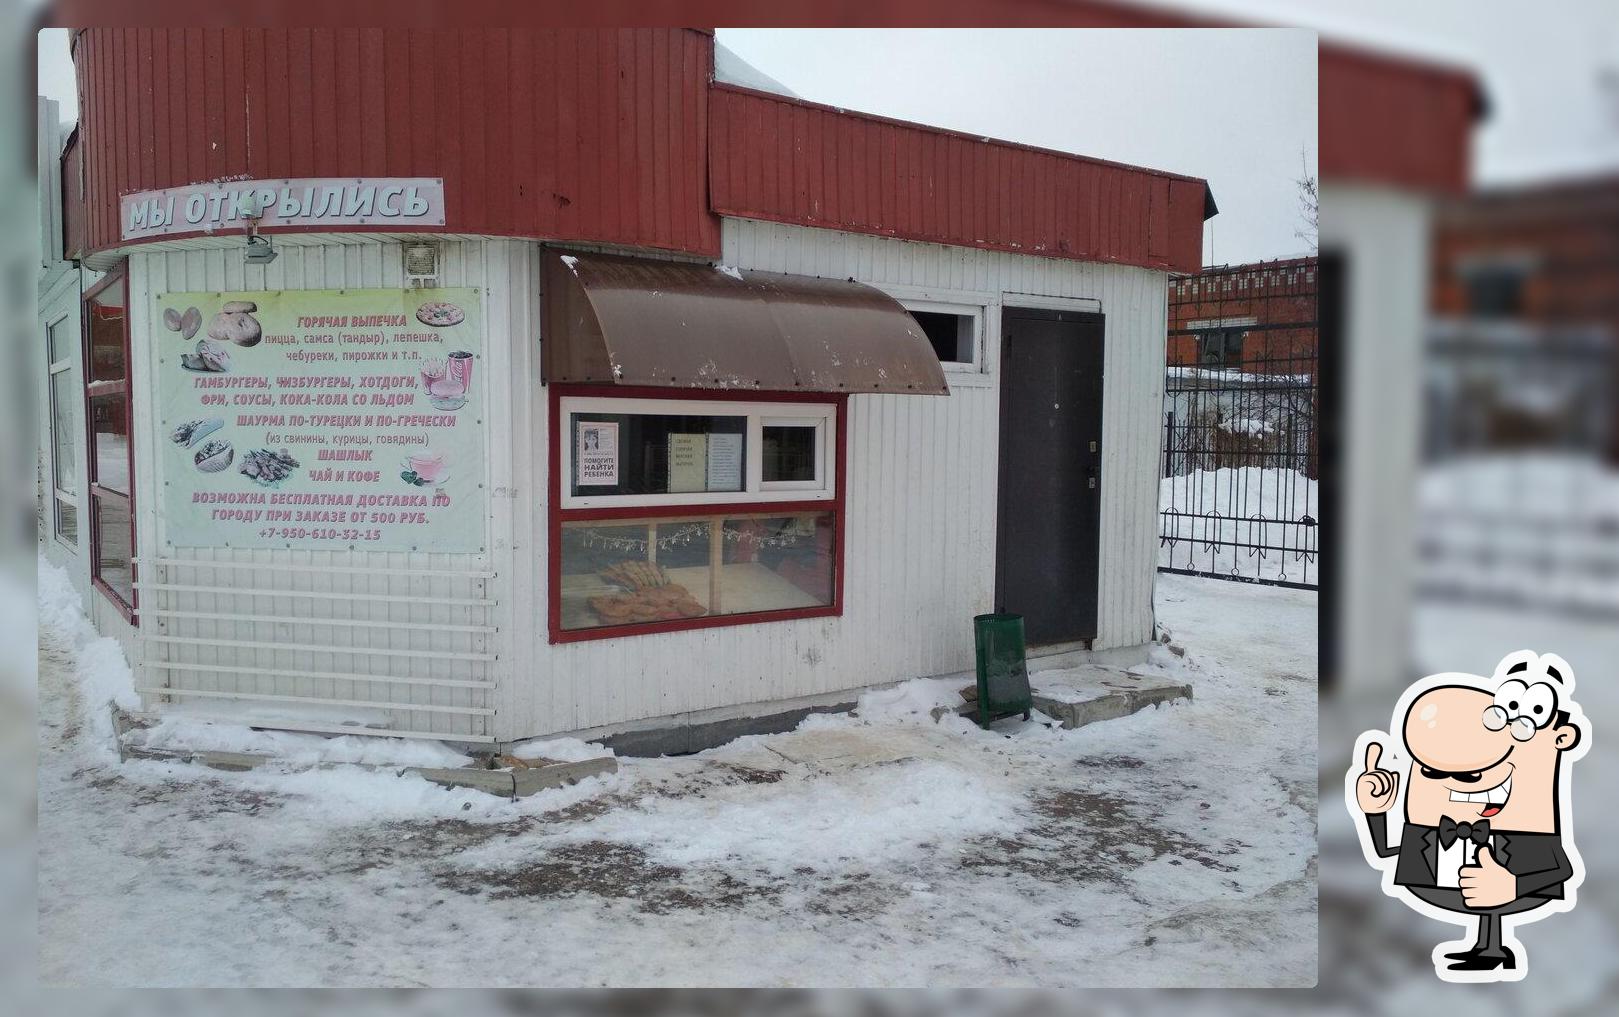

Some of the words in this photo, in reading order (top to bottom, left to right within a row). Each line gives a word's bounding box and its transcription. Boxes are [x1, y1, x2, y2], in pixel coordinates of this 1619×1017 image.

[129, 196, 176, 231] МЫ
[185, 187, 430, 224] ОТКРЫЛИСЬ
[297, 315, 349, 328] ГОРЯЧАЯ
[351, 315, 407, 328] ВЫПЕЧКА
[264, 334, 300, 345] пицца,
[303, 333, 334, 344] самса
[338, 331, 389, 345] (тандыр),
[393, 332, 443, 344] лепешка,
[286, 350, 338, 363] чебуреки,
[342, 351, 388, 363] пирожки
[392, 351, 398, 360] и
[401, 351, 422, 360] т.п.
[194, 376, 272, 390] ГАМБУРГЕРЫ,
[276, 376, 355, 390] ЧИЗБУРГЕРЫ,
[359, 375, 419, 390] ХОТДОГИ,
[201, 394, 229, 407] ФРИ,
[233, 393, 276, 407] СОУСЫ,
[280, 393, 348, 406] КОКА-КОЛА
[352, 393, 367, 406] СО
[370, 393, 415, 407] ЛЬДОМ
[237, 415, 285, 427] ШАУРМА
[288, 415, 361, 429] ПО-ТУРЕЦКИ
[364, 415, 373, 427] И
[376, 415, 457, 428] ПО-ГРЕЧЕСКИ
[266, 431, 281, 445] (из
[284, 434, 329, 445] свинины,
[332, 435, 372, 446] курицы,
[376, 431, 429, 447] говядины)
[318, 449, 373, 461] ШАШЛЫК
[584, 463, 614, 471] НАЙТИ
[309, 467, 333, 481] ЧАЙ
[335, 470, 344, 481] И
[347, 470, 381, 482] КОФЕ
[192, 492, 266, 504] ВОЗМОЖНА
[269, 493, 354, 506] БЕСПЛАТНАЯ
[357, 494, 428, 508] ДОСТАВКА
[432, 495, 451, 507] ПО
[211, 509, 263, 523] ГОРОДУ
[266, 510, 292, 521] ПРИ
[295, 511, 347, 523] ЗАКАЗЕ
[350, 512, 367, 523] ОТ
[370, 512, 397, 524] 500
[399, 512, 430, 524] РУБ.
